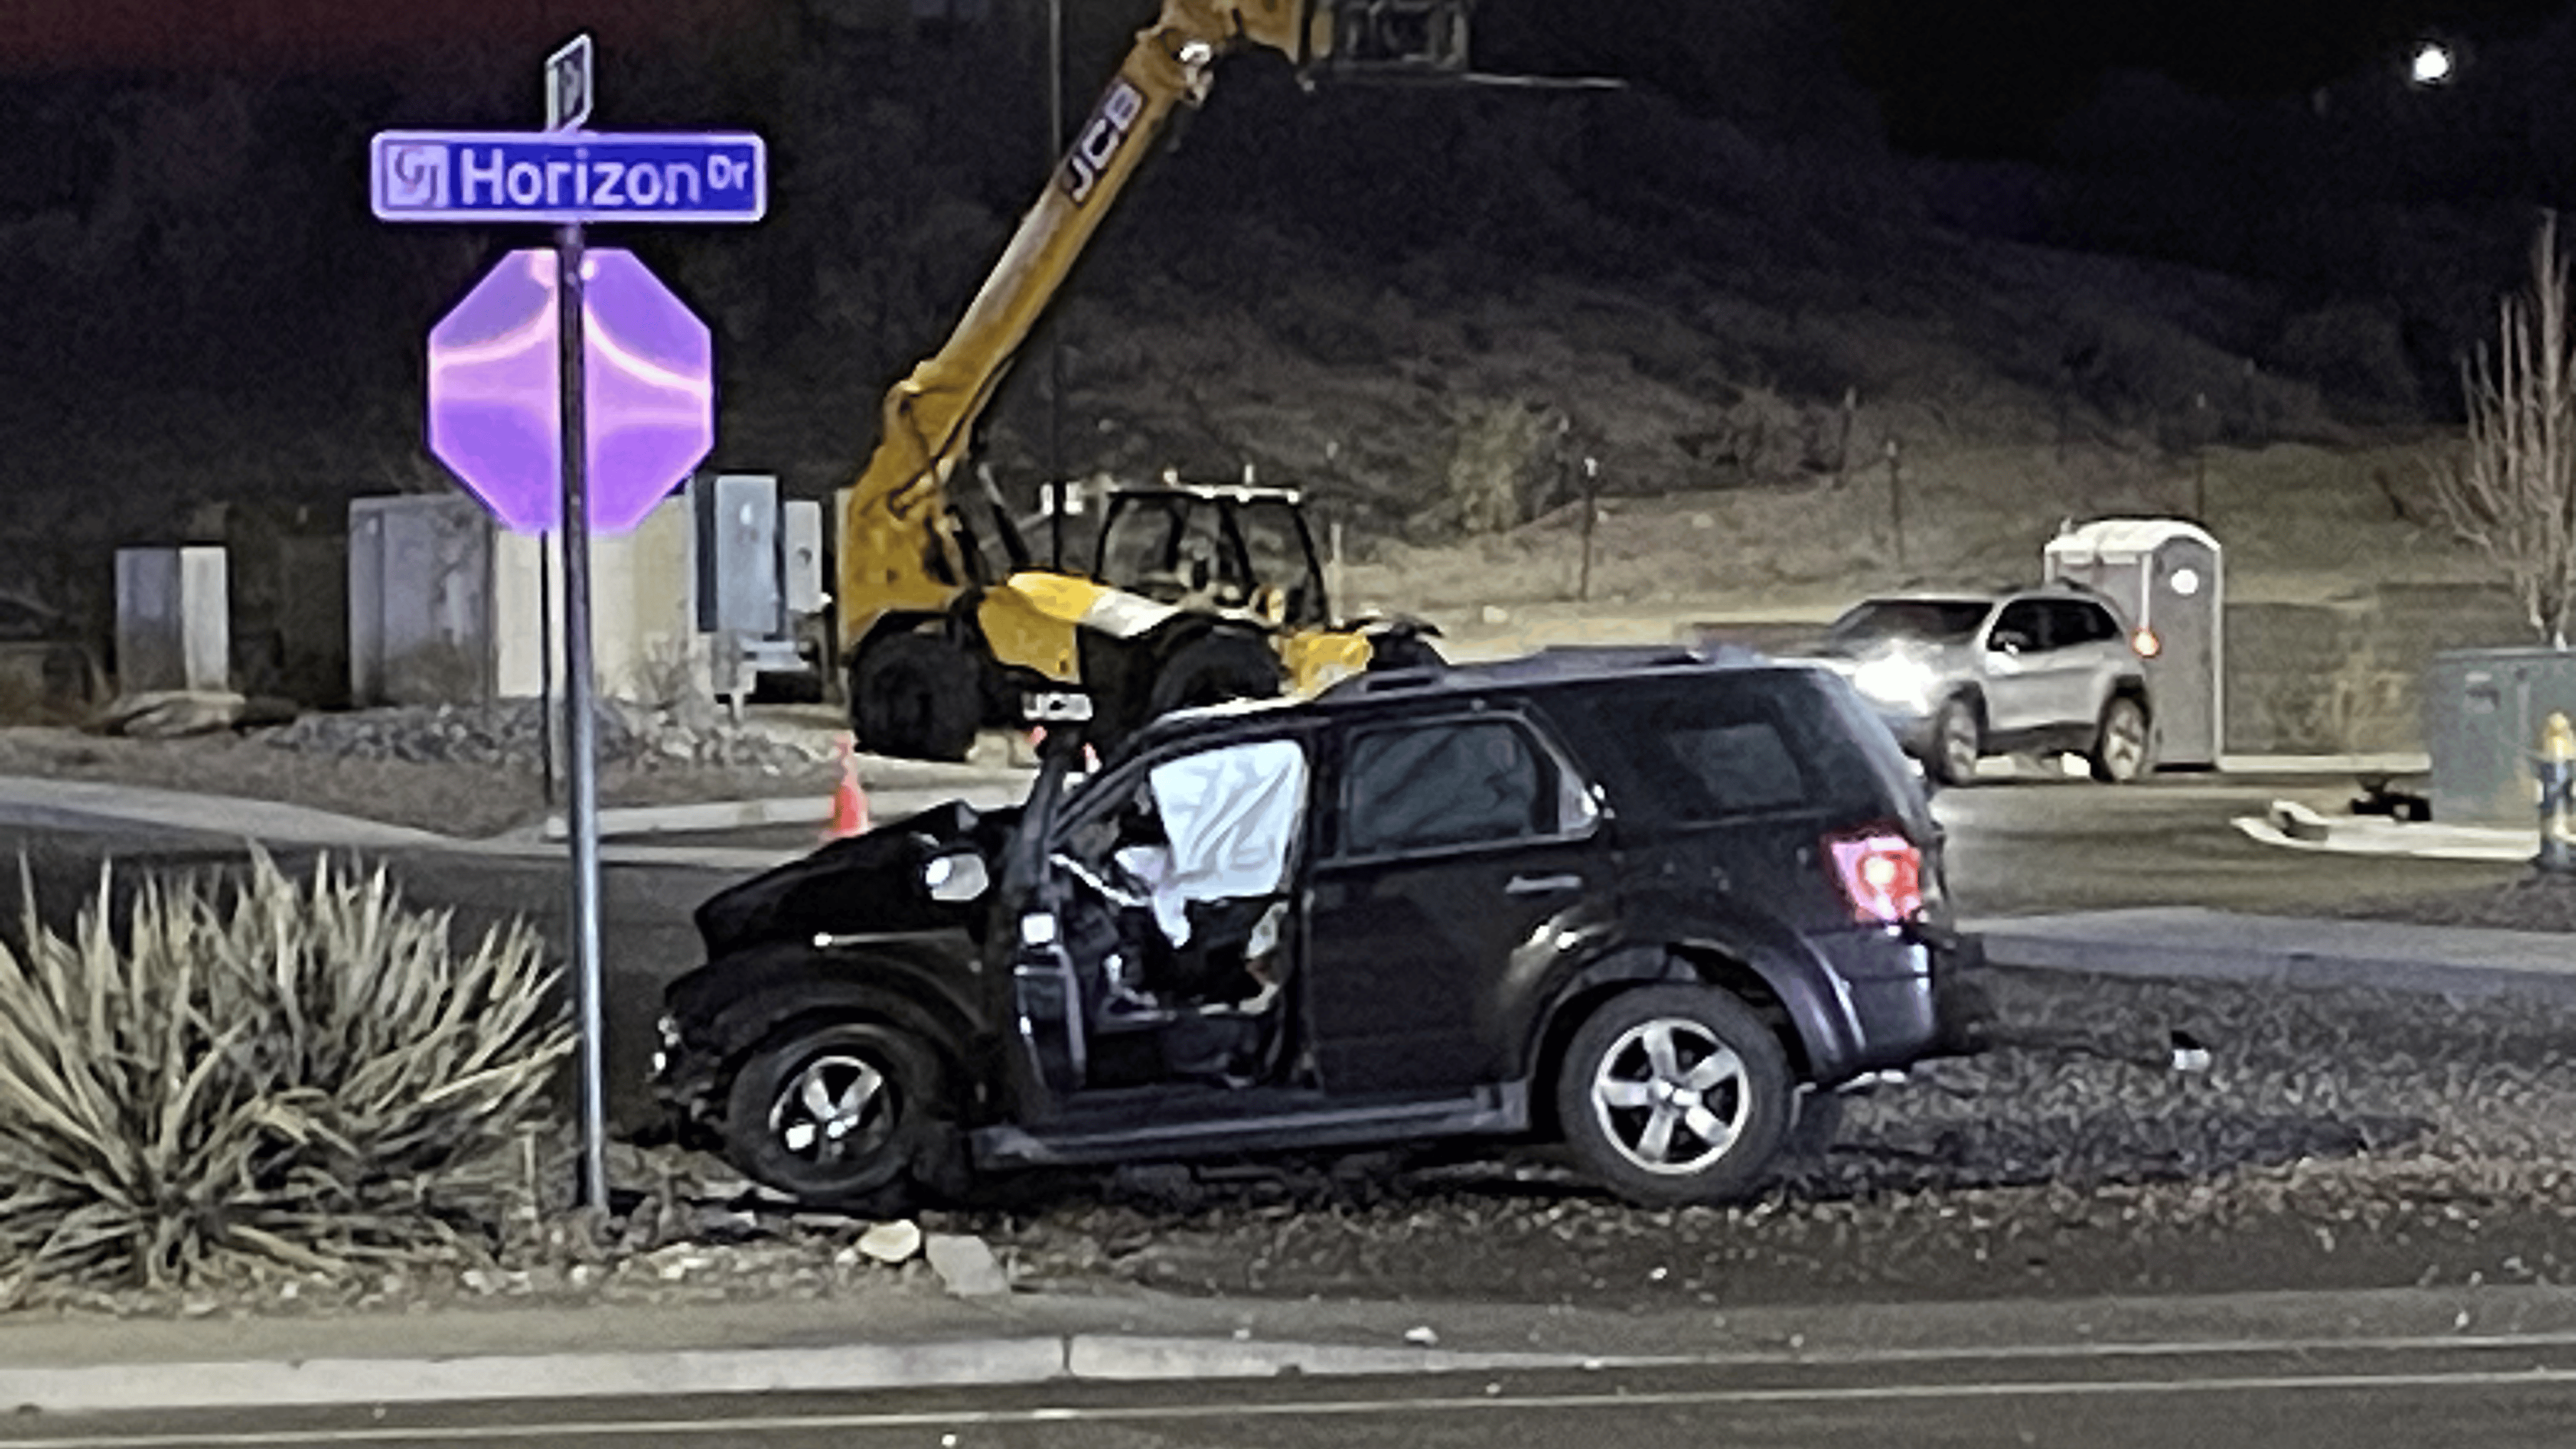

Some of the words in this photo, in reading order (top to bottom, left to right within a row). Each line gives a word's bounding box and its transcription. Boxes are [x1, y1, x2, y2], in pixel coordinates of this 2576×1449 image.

[460, 148, 700, 205] Horizon
[707, 155, 750, 190] Dr
[1071, 83, 1142, 203] JCB
